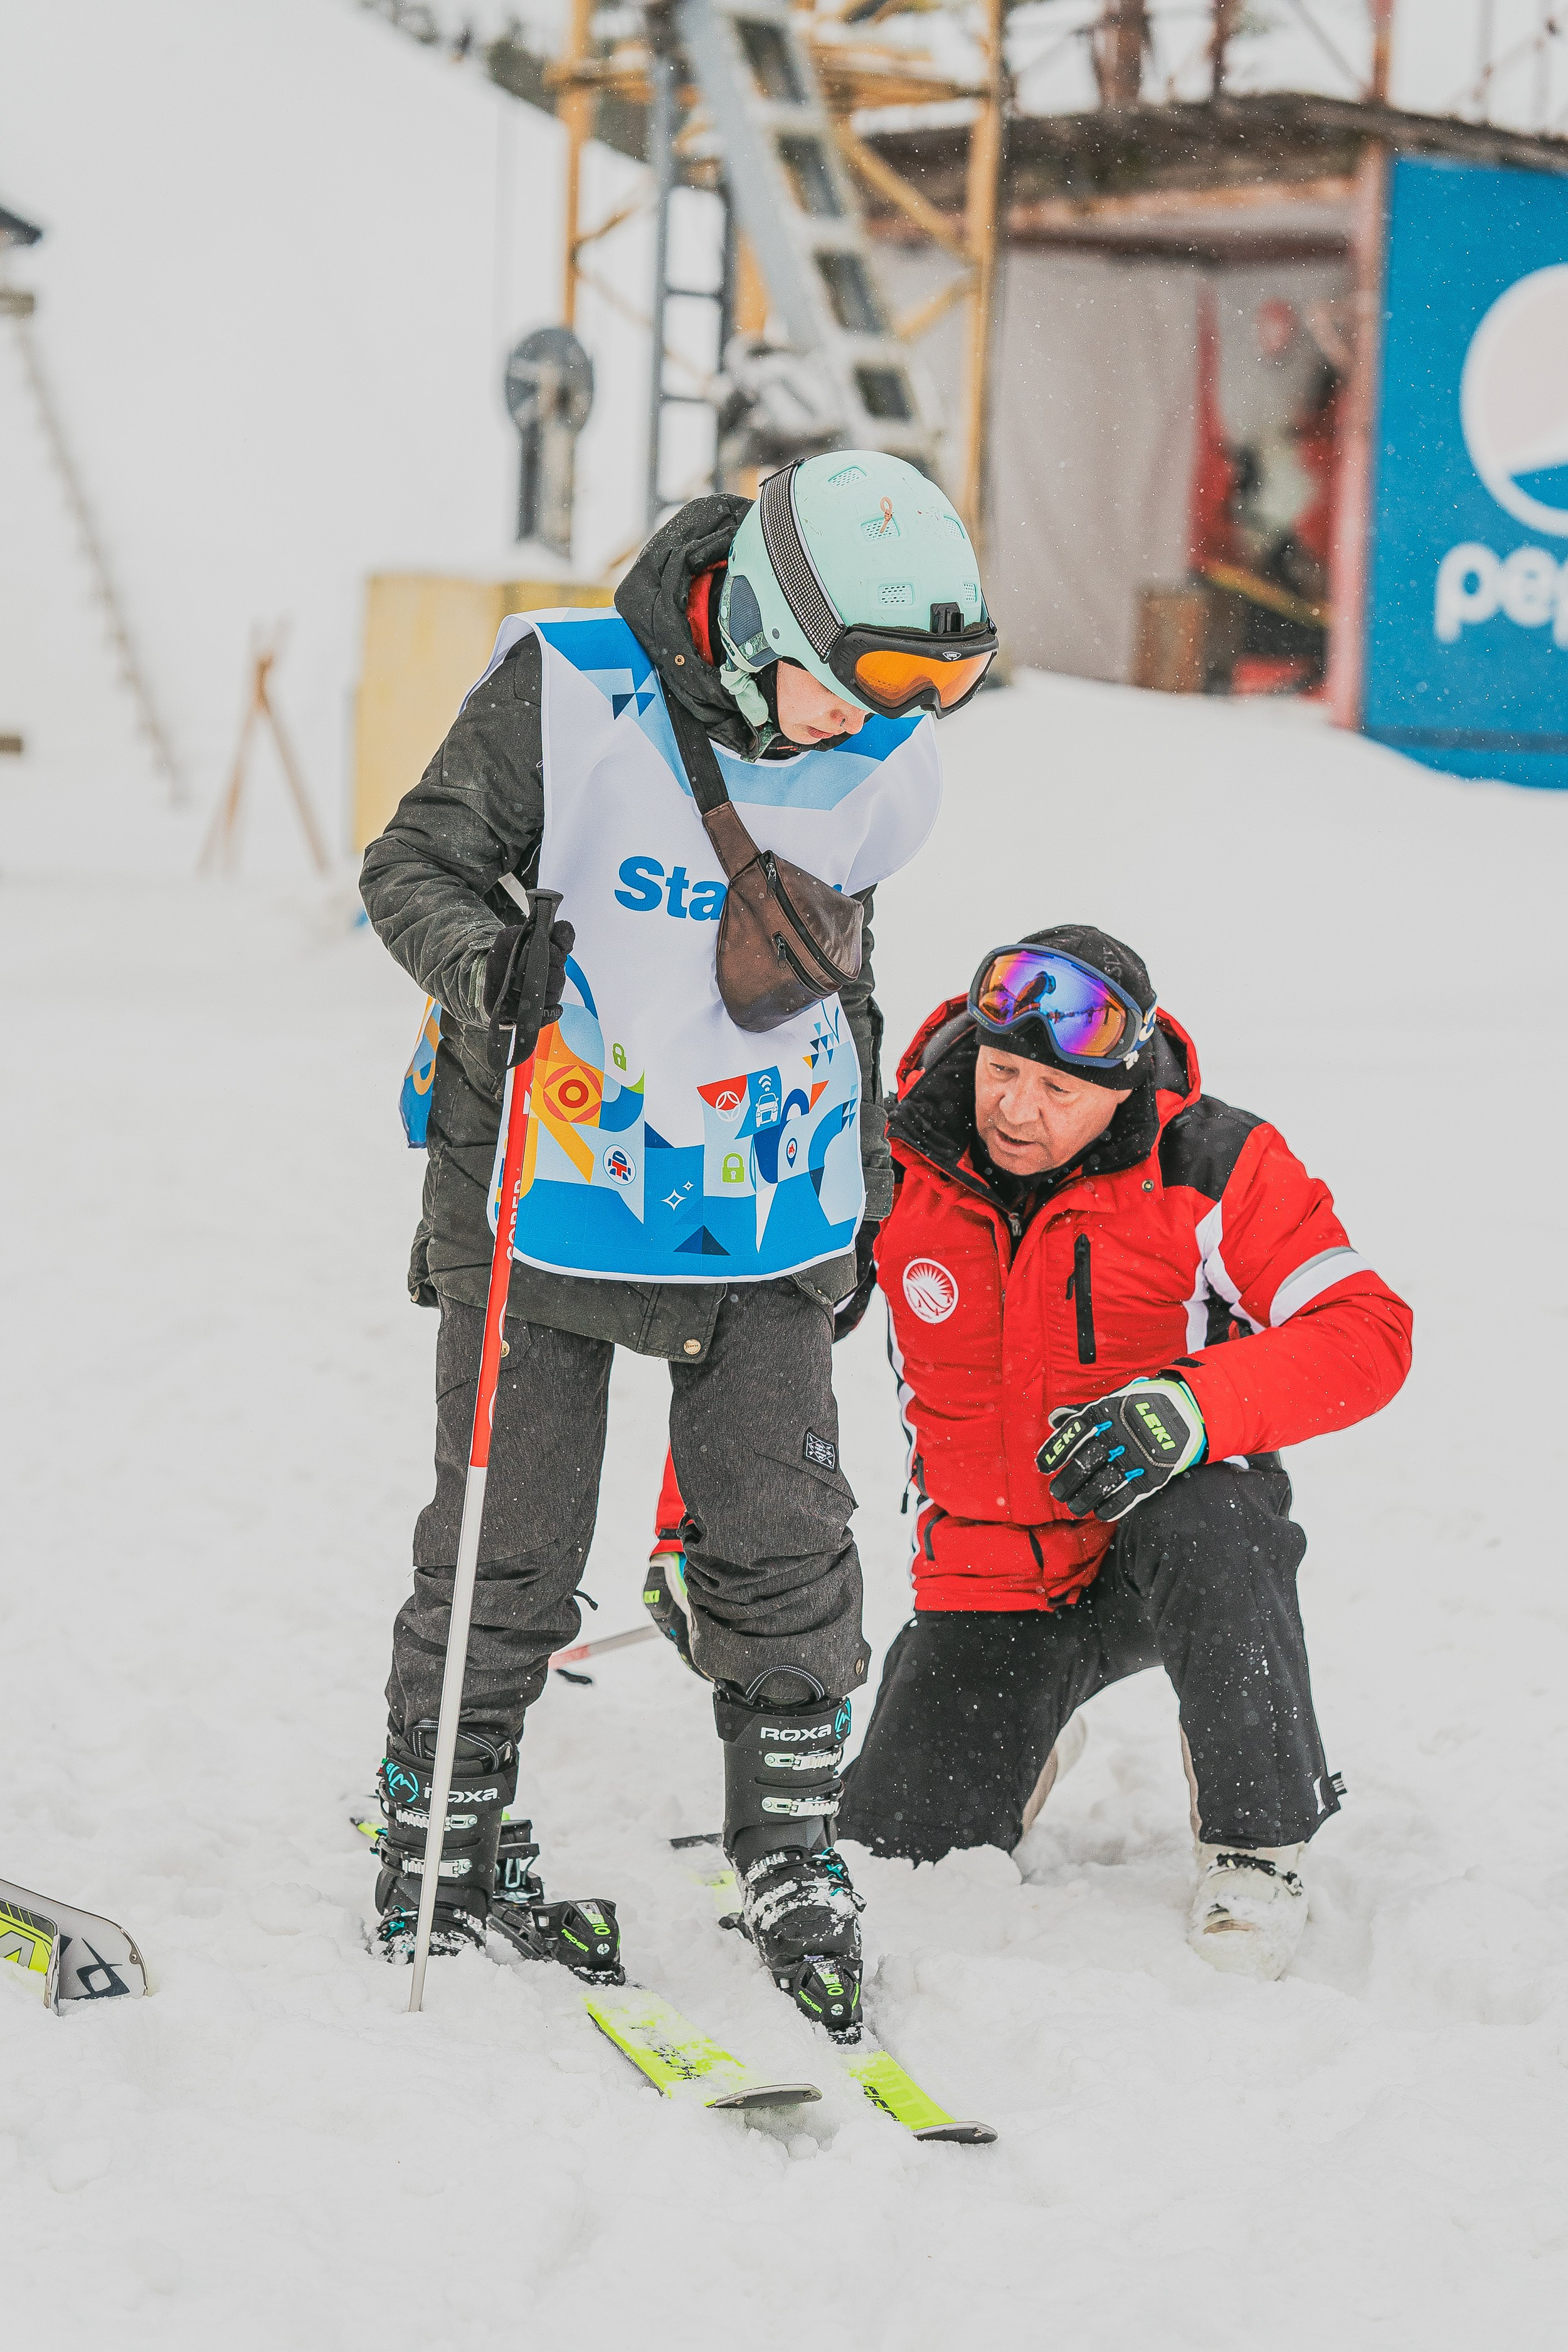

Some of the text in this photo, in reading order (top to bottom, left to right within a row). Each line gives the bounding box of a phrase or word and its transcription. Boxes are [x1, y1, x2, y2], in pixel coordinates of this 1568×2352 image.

[1434, 542, 1568, 650] pe
[614, 856, 725, 921] Sta
[1045, 1421, 1083, 1466] LEKI
[1135, 1402, 1177, 1451] LEKI
[561, 1929, 590, 1952] FISCHER
[798, 1990, 823, 2014] FISCHER
